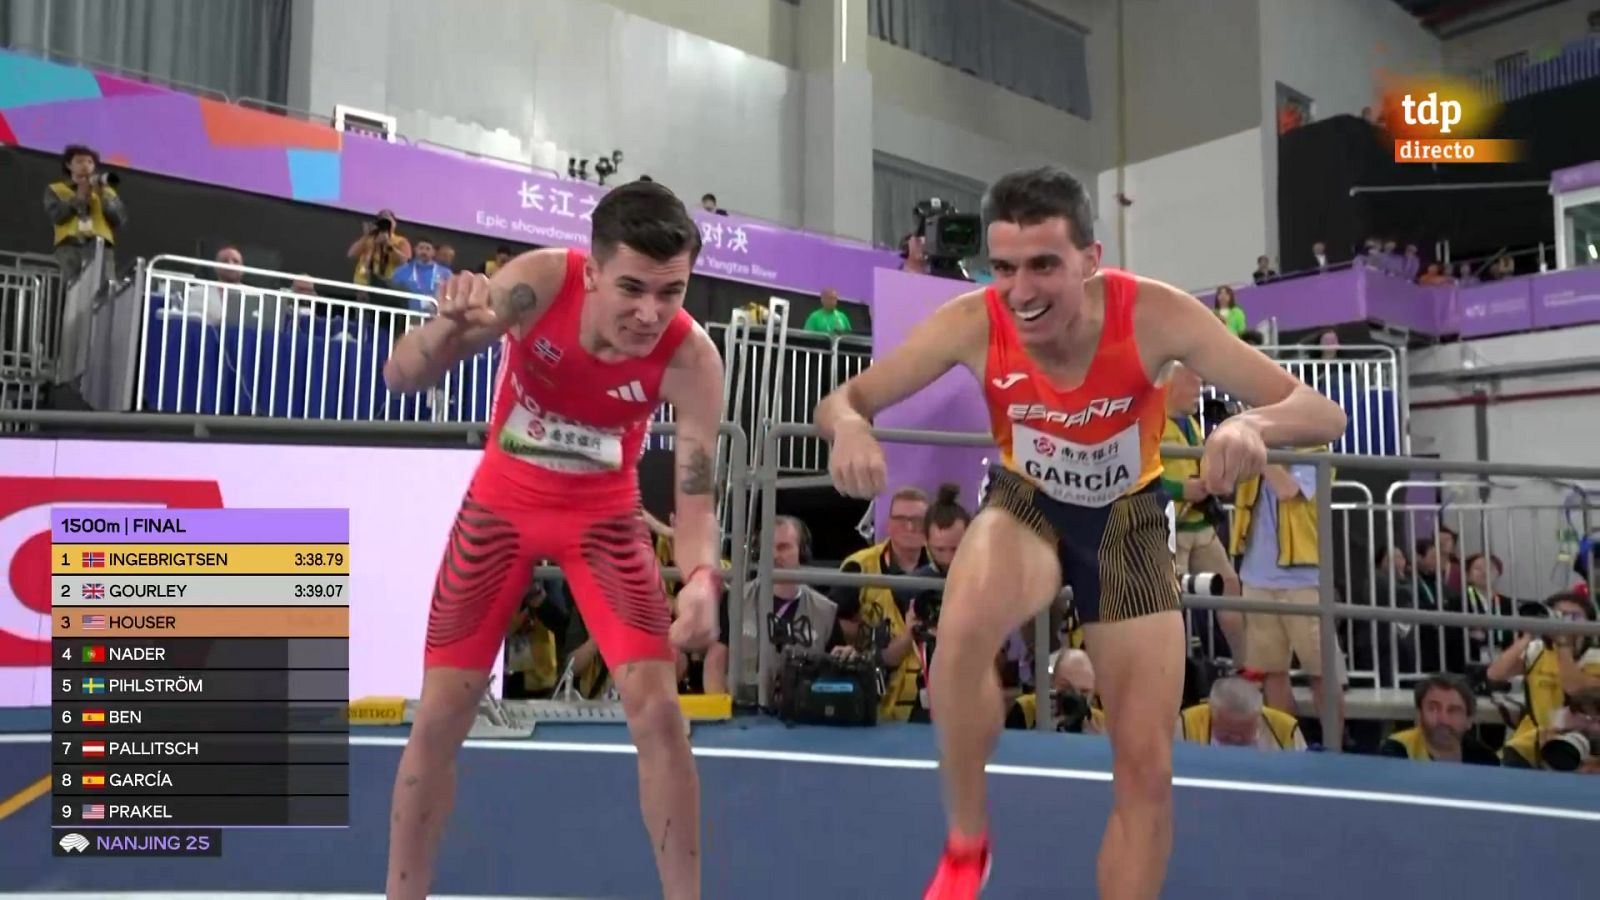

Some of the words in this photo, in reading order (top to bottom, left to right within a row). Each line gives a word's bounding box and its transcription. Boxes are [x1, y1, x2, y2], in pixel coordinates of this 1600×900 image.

[476, 210, 508, 229] Epic
[511, 218, 588, 243] showdowns
[706, 256, 750, 276] Yangtze
[752, 263, 778, 280] River
[1007, 396, 1133, 428] ESPAÑA
[1025, 460, 1129, 491] GARCÍA
